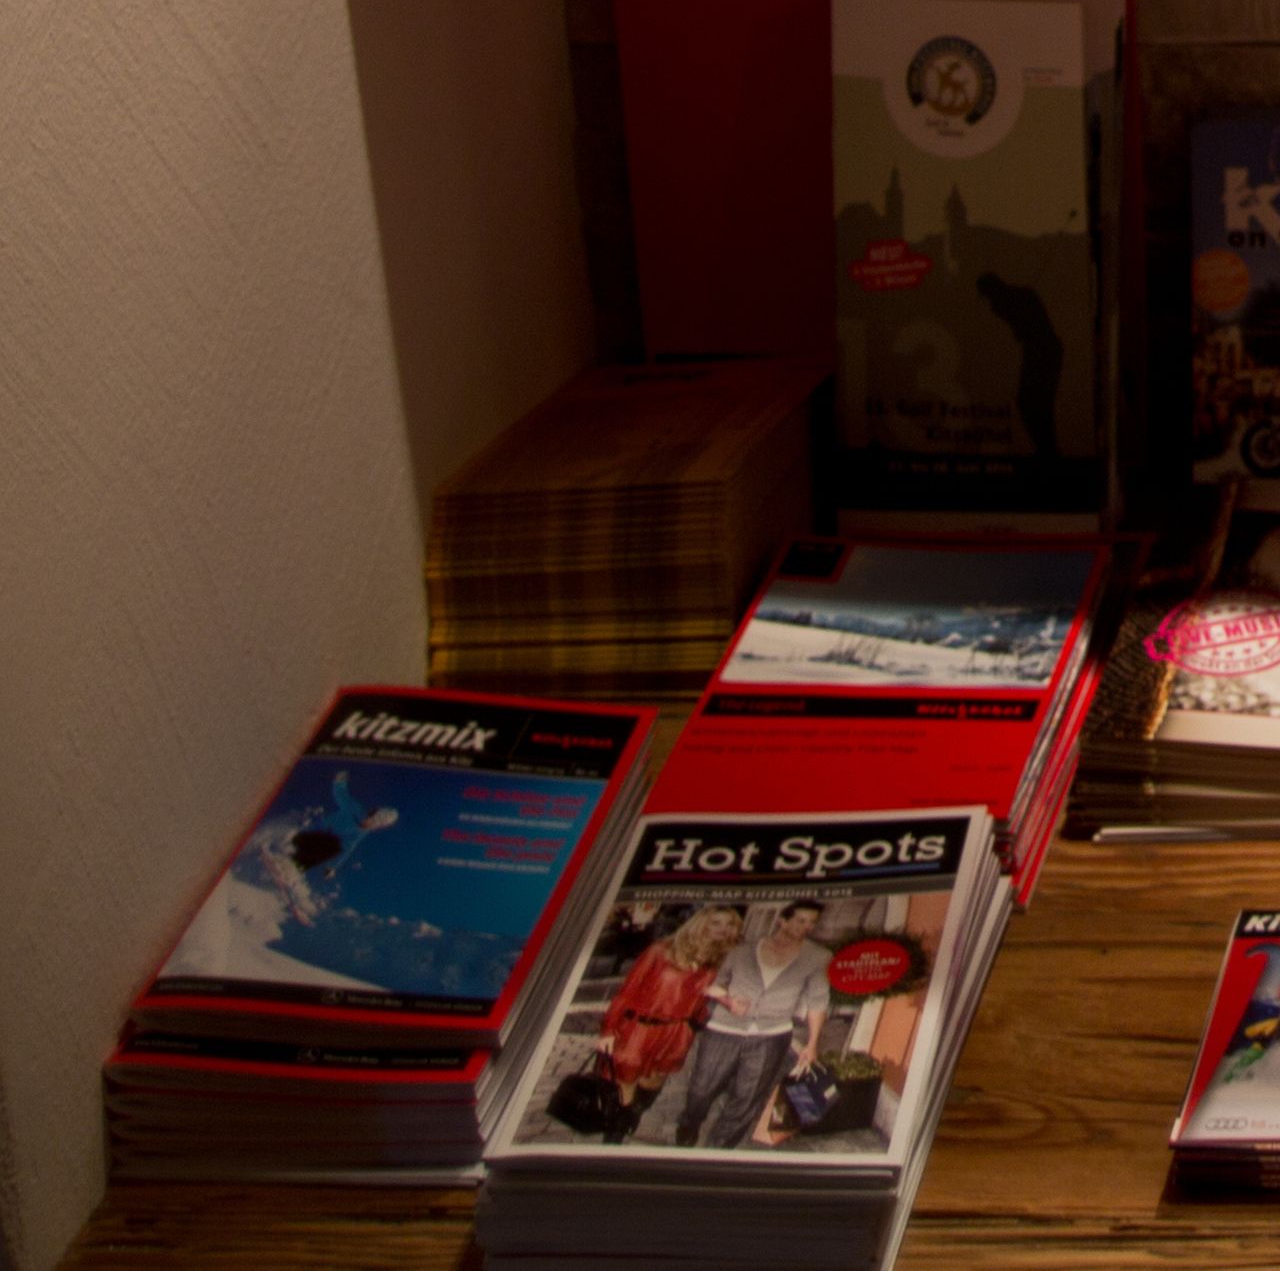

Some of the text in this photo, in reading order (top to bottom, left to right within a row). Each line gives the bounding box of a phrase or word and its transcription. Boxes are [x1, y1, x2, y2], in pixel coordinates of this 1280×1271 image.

[1228, 231, 1267, 248] on
[331, 709, 498, 753] kitzmix
[644, 831, 947, 879] Hot Spots
